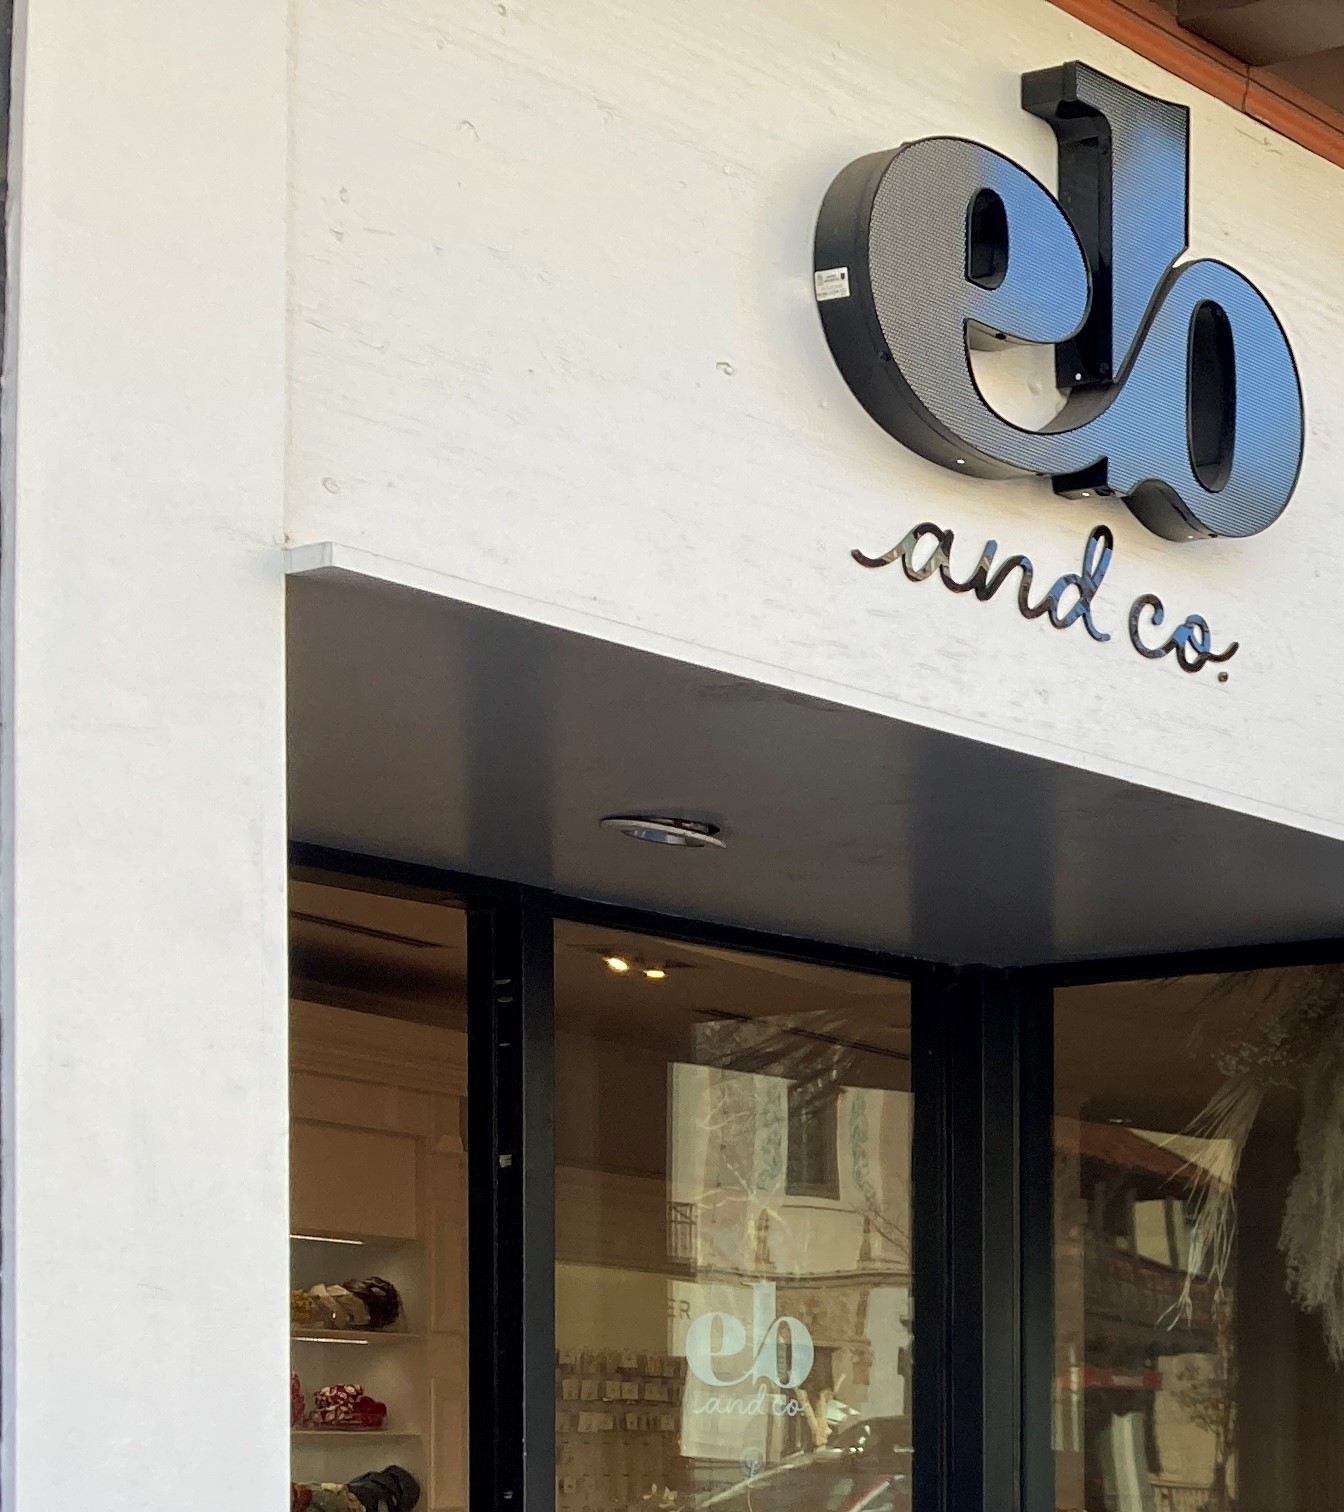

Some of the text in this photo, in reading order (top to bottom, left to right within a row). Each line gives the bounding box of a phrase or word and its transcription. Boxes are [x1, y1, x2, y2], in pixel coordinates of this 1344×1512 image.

[814, 60, 1305, 539] eb
[850, 522, 1111, 643] and
[692, 1383, 767, 1415] and
